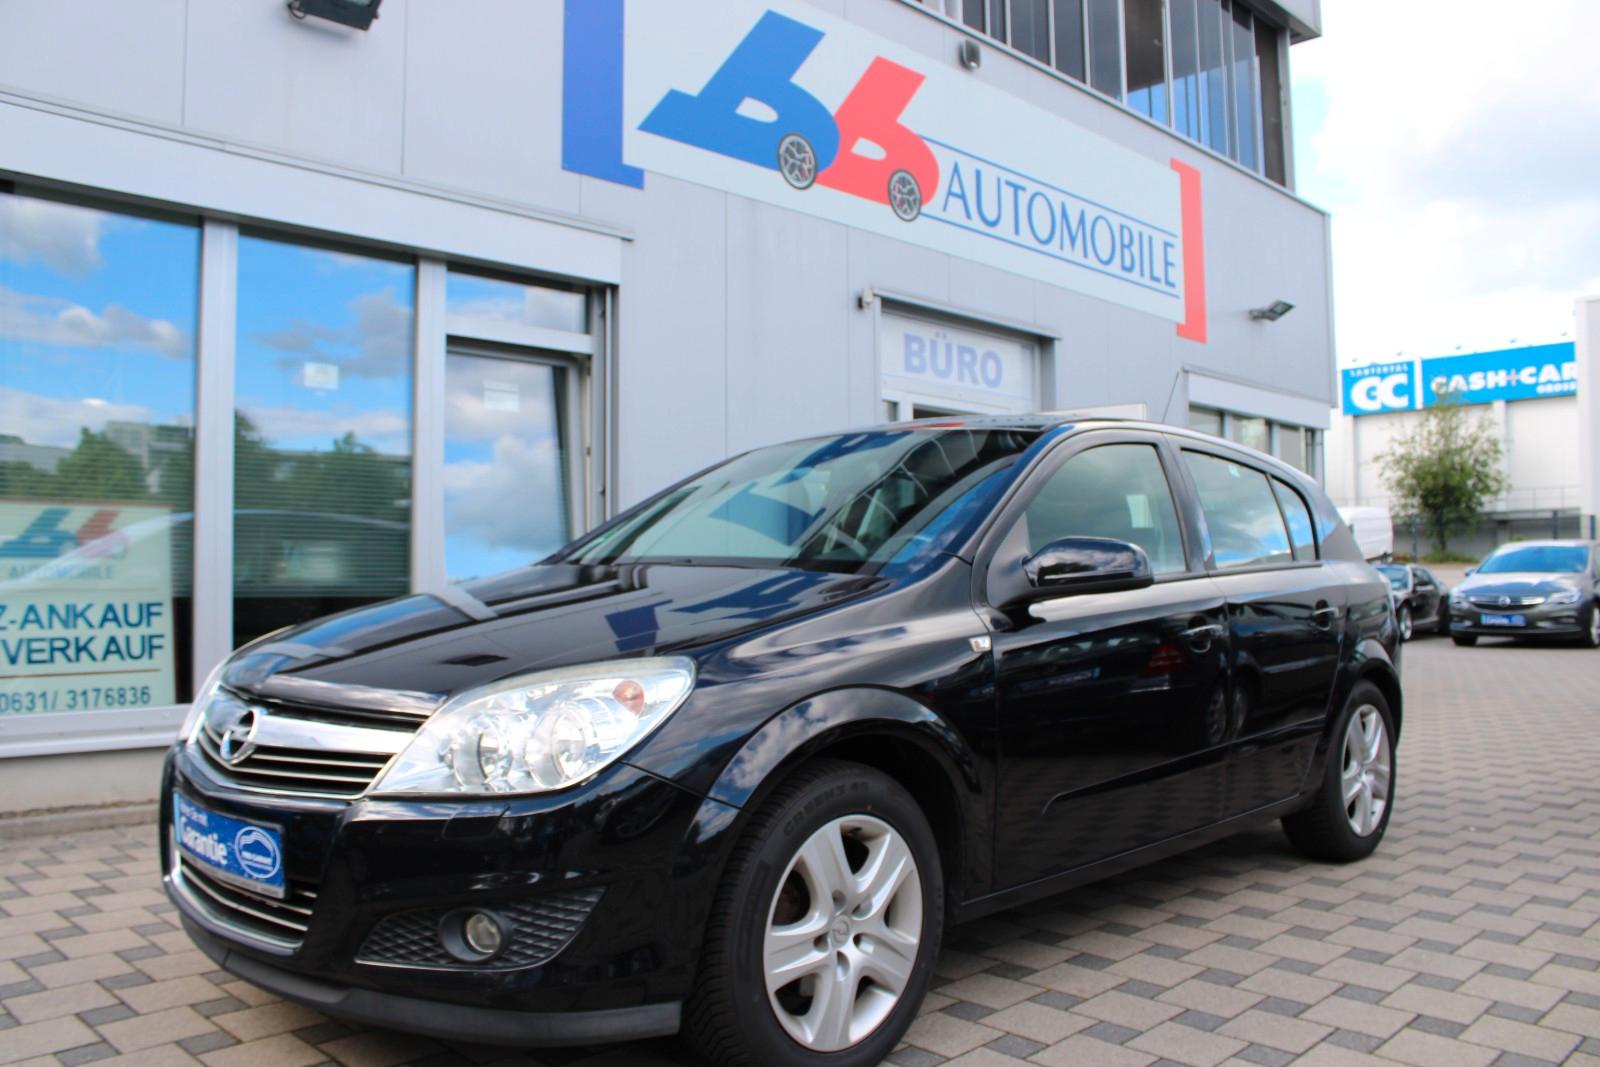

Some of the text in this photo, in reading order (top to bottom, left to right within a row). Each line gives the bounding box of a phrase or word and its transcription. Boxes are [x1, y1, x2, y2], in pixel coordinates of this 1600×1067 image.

[943, 160, 1176, 288] AUTOMOBILE
[903, 331, 1003, 388] BÜRO
[1, 634, 165, 666] VERKAUF
[66, 686, 151, 709] 3176836
